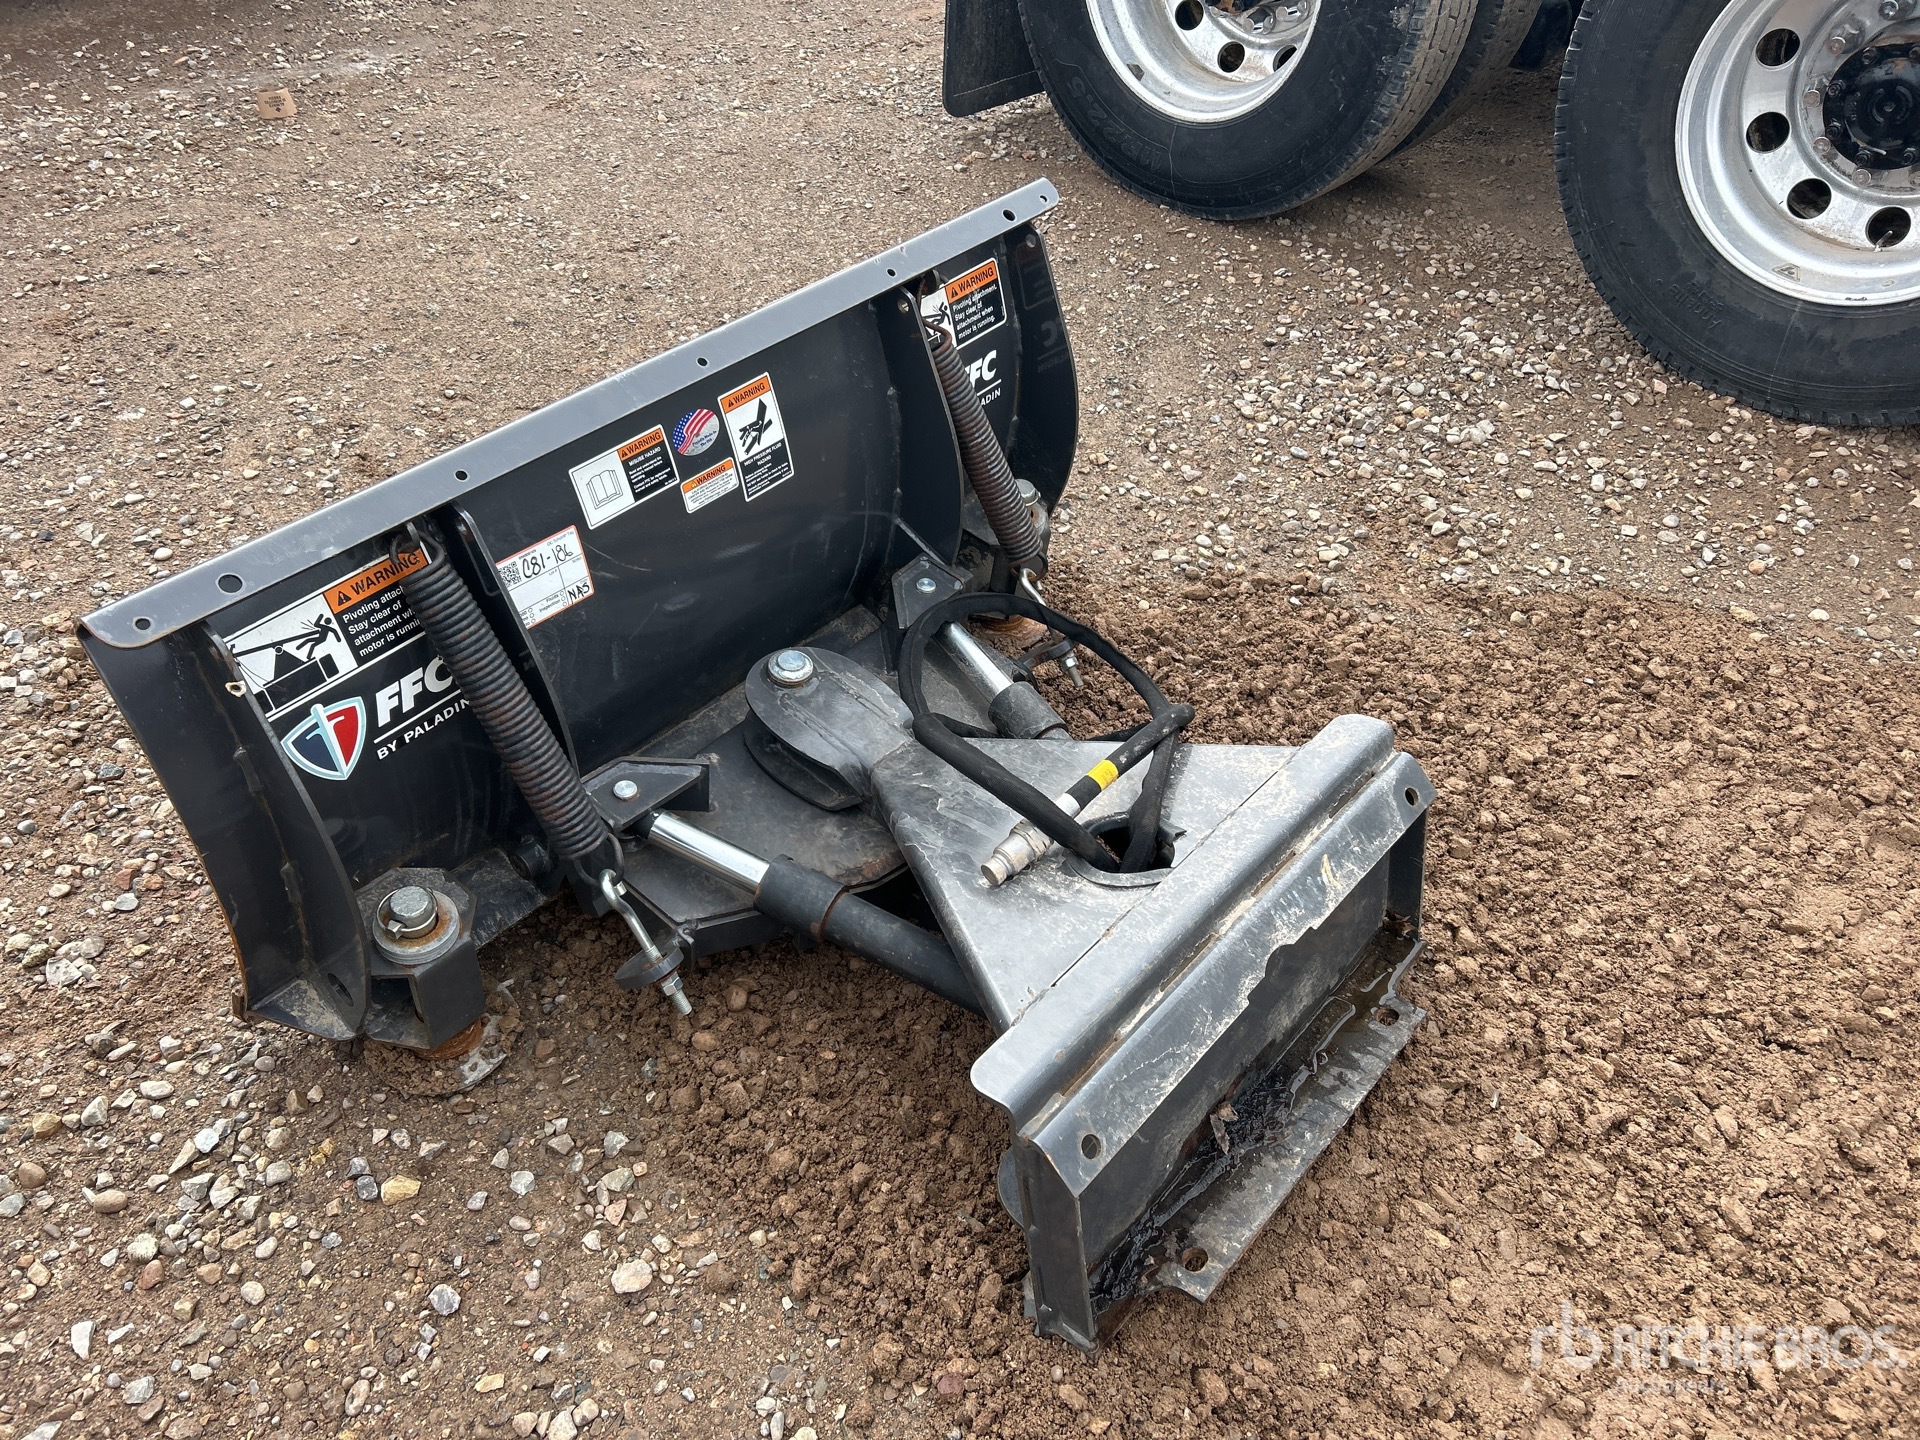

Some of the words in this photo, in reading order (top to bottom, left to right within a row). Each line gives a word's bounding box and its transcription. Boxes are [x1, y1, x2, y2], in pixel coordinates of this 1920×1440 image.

[957, 267, 994, 293] WARNING
[957, 312, 981, 331] attachment
[965, 350, 997, 389] FC
[733, 382, 766, 404] WARNING
[626, 432, 661, 454] WARNING
[696, 464, 726, 485] WARNING
[350, 552, 421, 596] WARNING
[342, 599, 381, 624] Pivoting
[348, 620, 369, 635] Stay
[369, 607, 391, 623] clear
[392, 600, 402, 612] of
[354, 614, 403, 646] attachment
[359, 638, 385, 657] motor
[385, 633, 395, 643] is
[375, 655, 453, 728] FFC
[376, 740, 397, 760] BY
